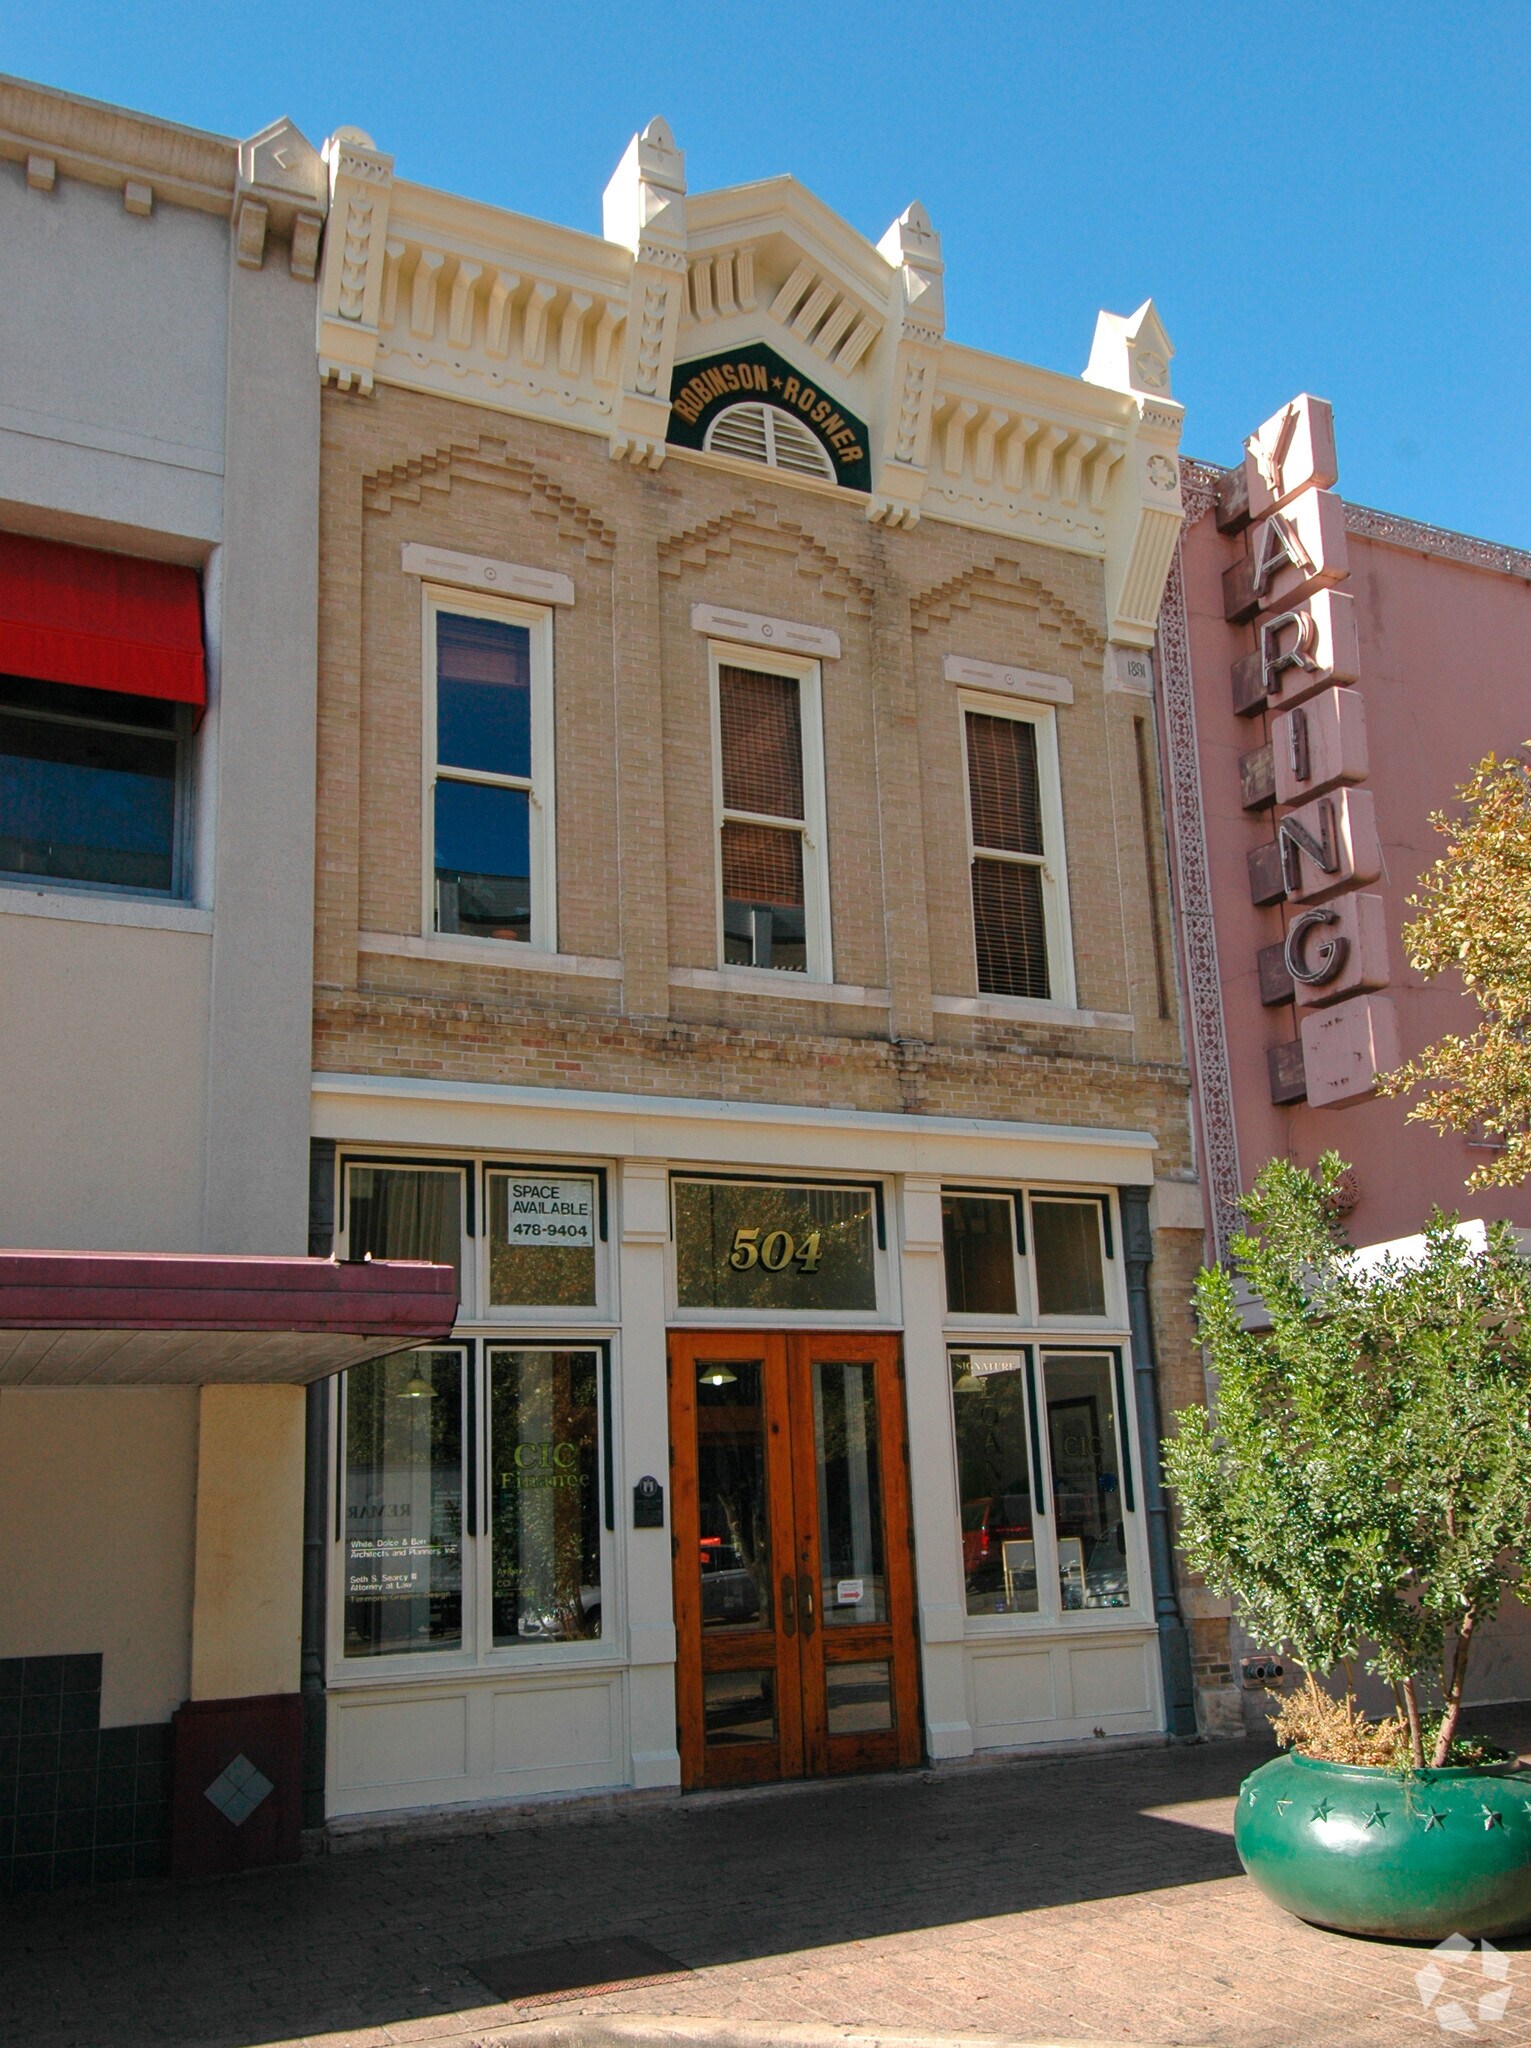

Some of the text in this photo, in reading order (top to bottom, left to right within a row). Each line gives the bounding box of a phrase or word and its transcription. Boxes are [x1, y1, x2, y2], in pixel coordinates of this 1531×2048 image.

[673, 363, 864, 463] ROBINSON ROSNER
[1127, 661, 1146, 678] 1891
[1247, 403, 1349, 986] YARING
[513, 1185, 560, 1199] SPACE
[513, 1201, 588, 1216] AVAILABLE
[513, 1223, 588, 1237] 478-9404
[729, 1227, 823, 1273] 504
[955, 1361, 1017, 1371] SIGNATURE
[1064, 1436, 1102, 1456] CIC
[514, 1442, 577, 1469] CIC
[501, 1472, 590, 1489] Finance
[351, 1550, 390, 1558] Architects
[392, 1548, 407, 1557] and
[351, 1575, 368, 1583] Seth
[382, 1573, 408, 1581] Searcy
[396, 1581, 412, 1589] Law
